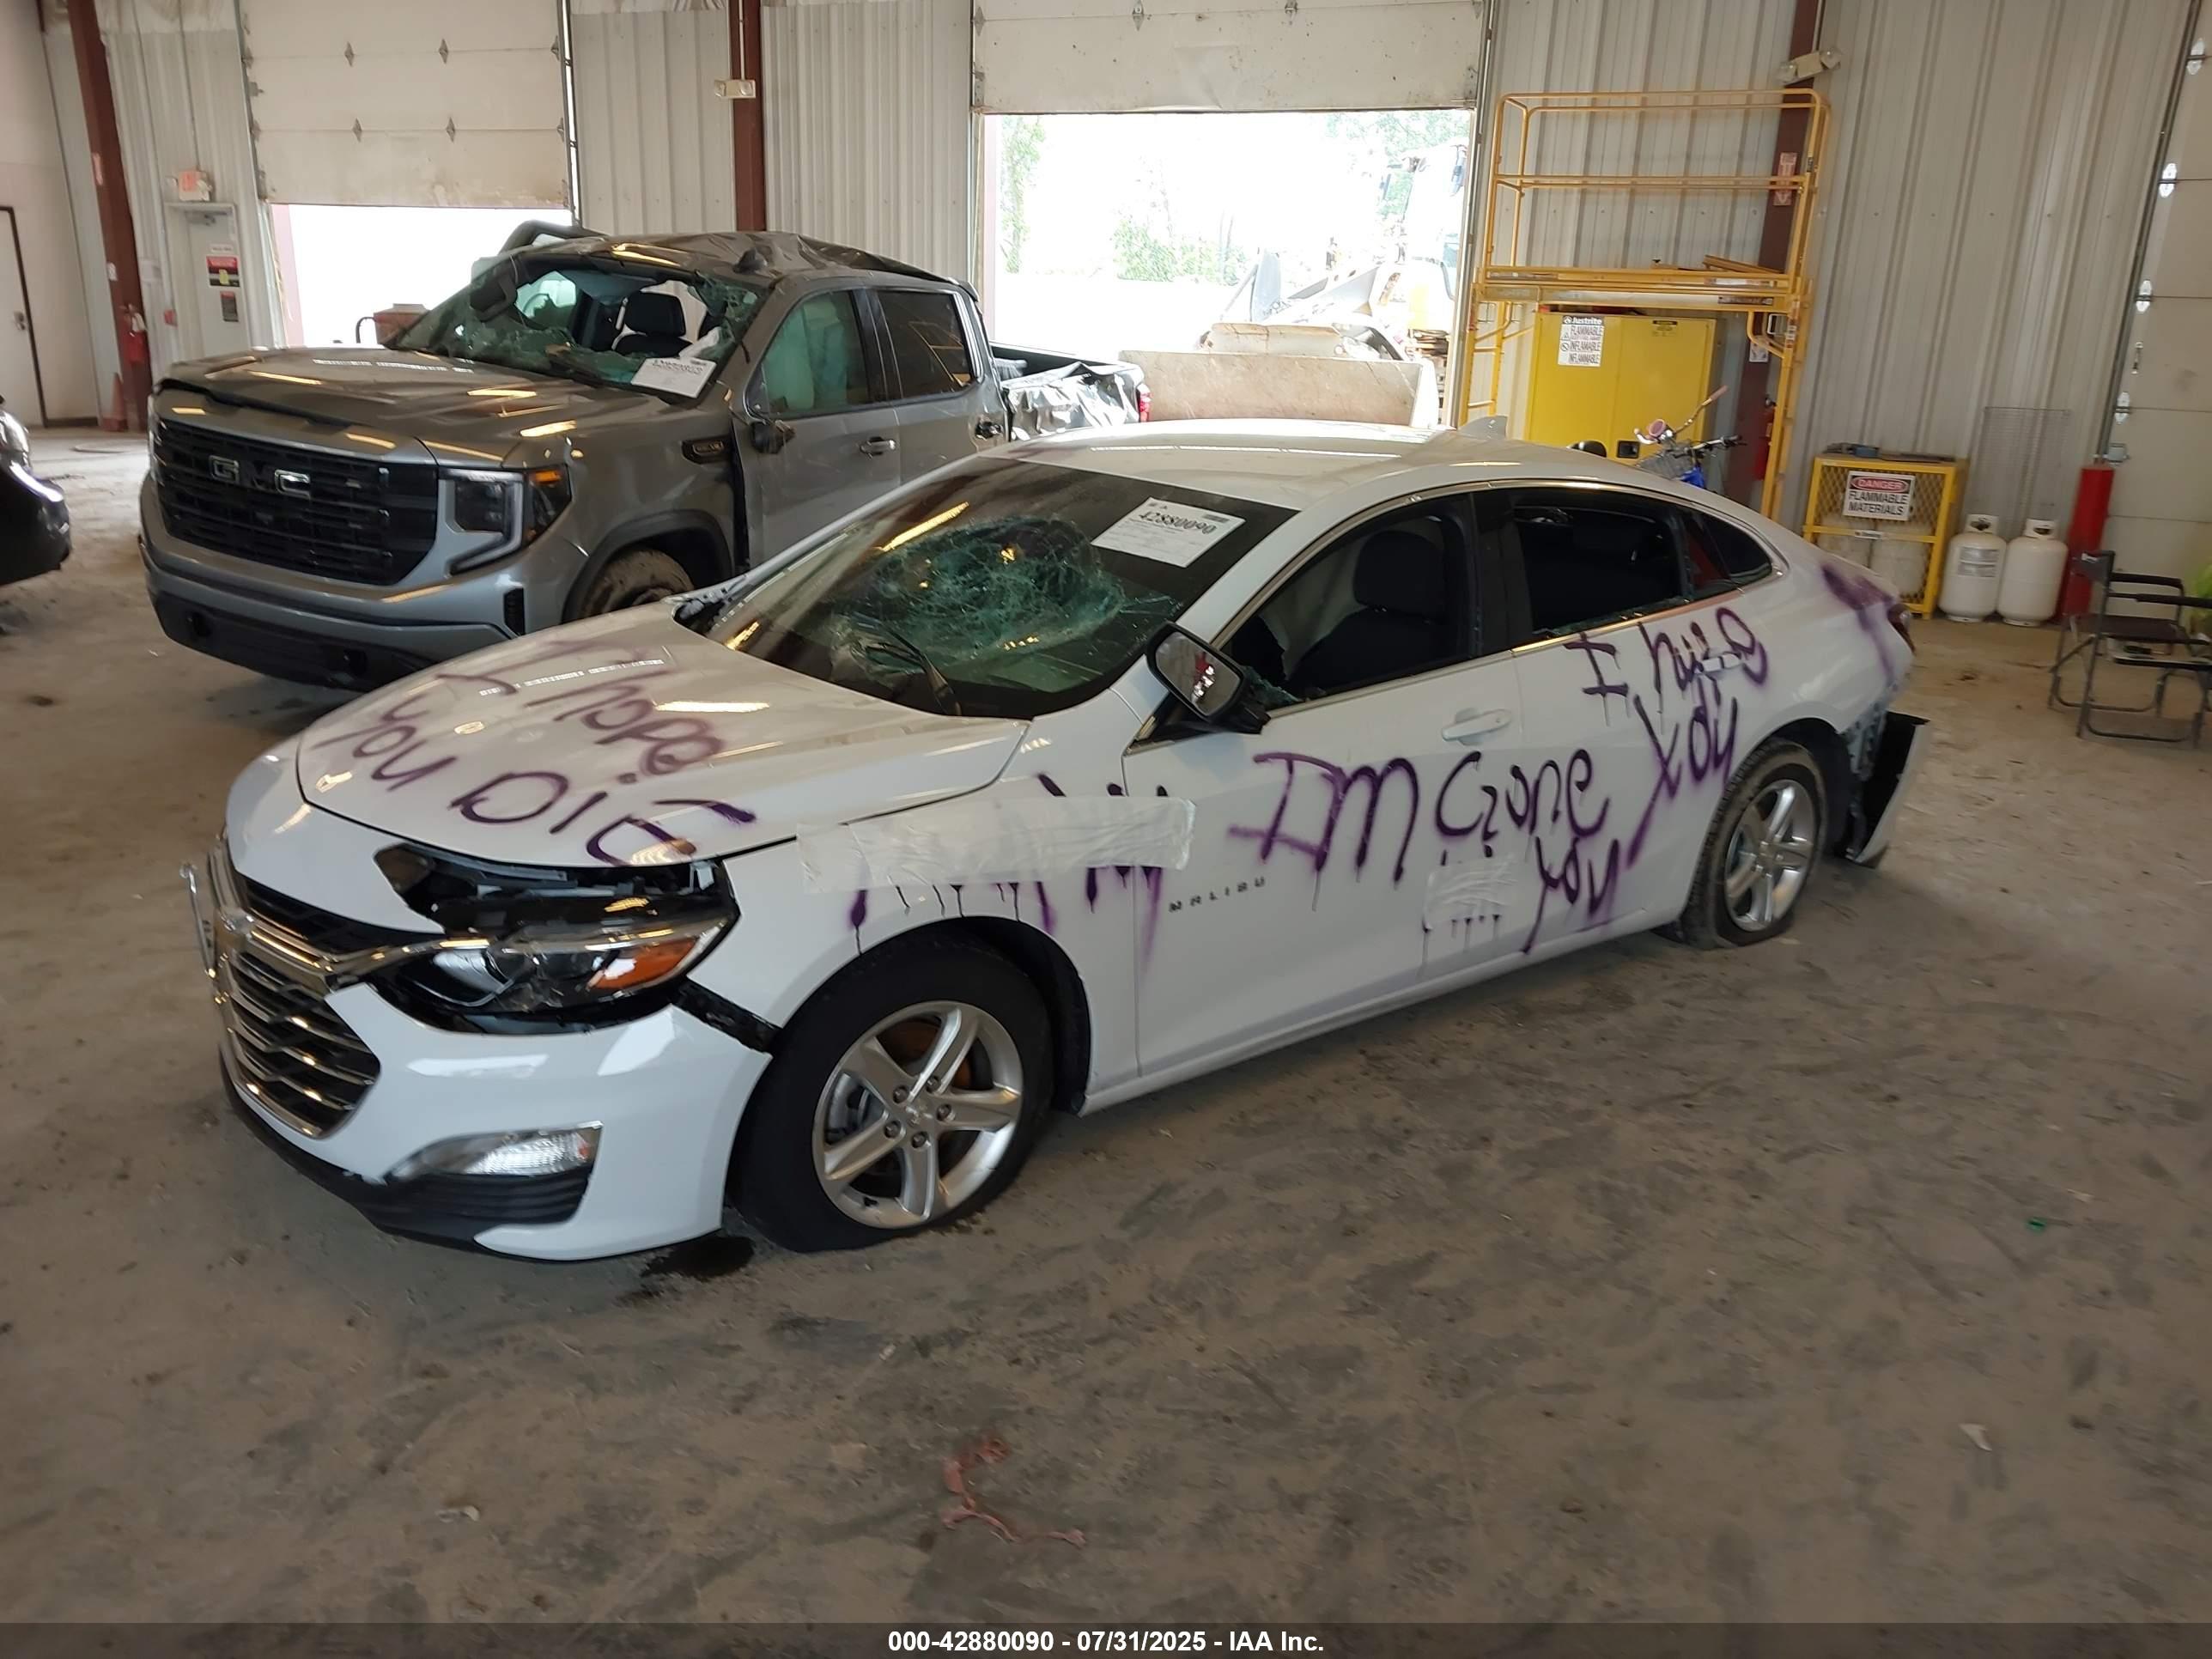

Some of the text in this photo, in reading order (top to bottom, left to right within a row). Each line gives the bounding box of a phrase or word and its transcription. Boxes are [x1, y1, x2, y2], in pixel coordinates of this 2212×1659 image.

[209, 454, 312, 500] GMC
[1857, 479, 1902, 490] DANGER
[1849, 490, 1908, 505] FLAMMABLE
[1849, 501, 1904, 515] MATERIALS
[1563, 629, 1629, 700] I
[1169, 875, 1266, 913] MALIBU
